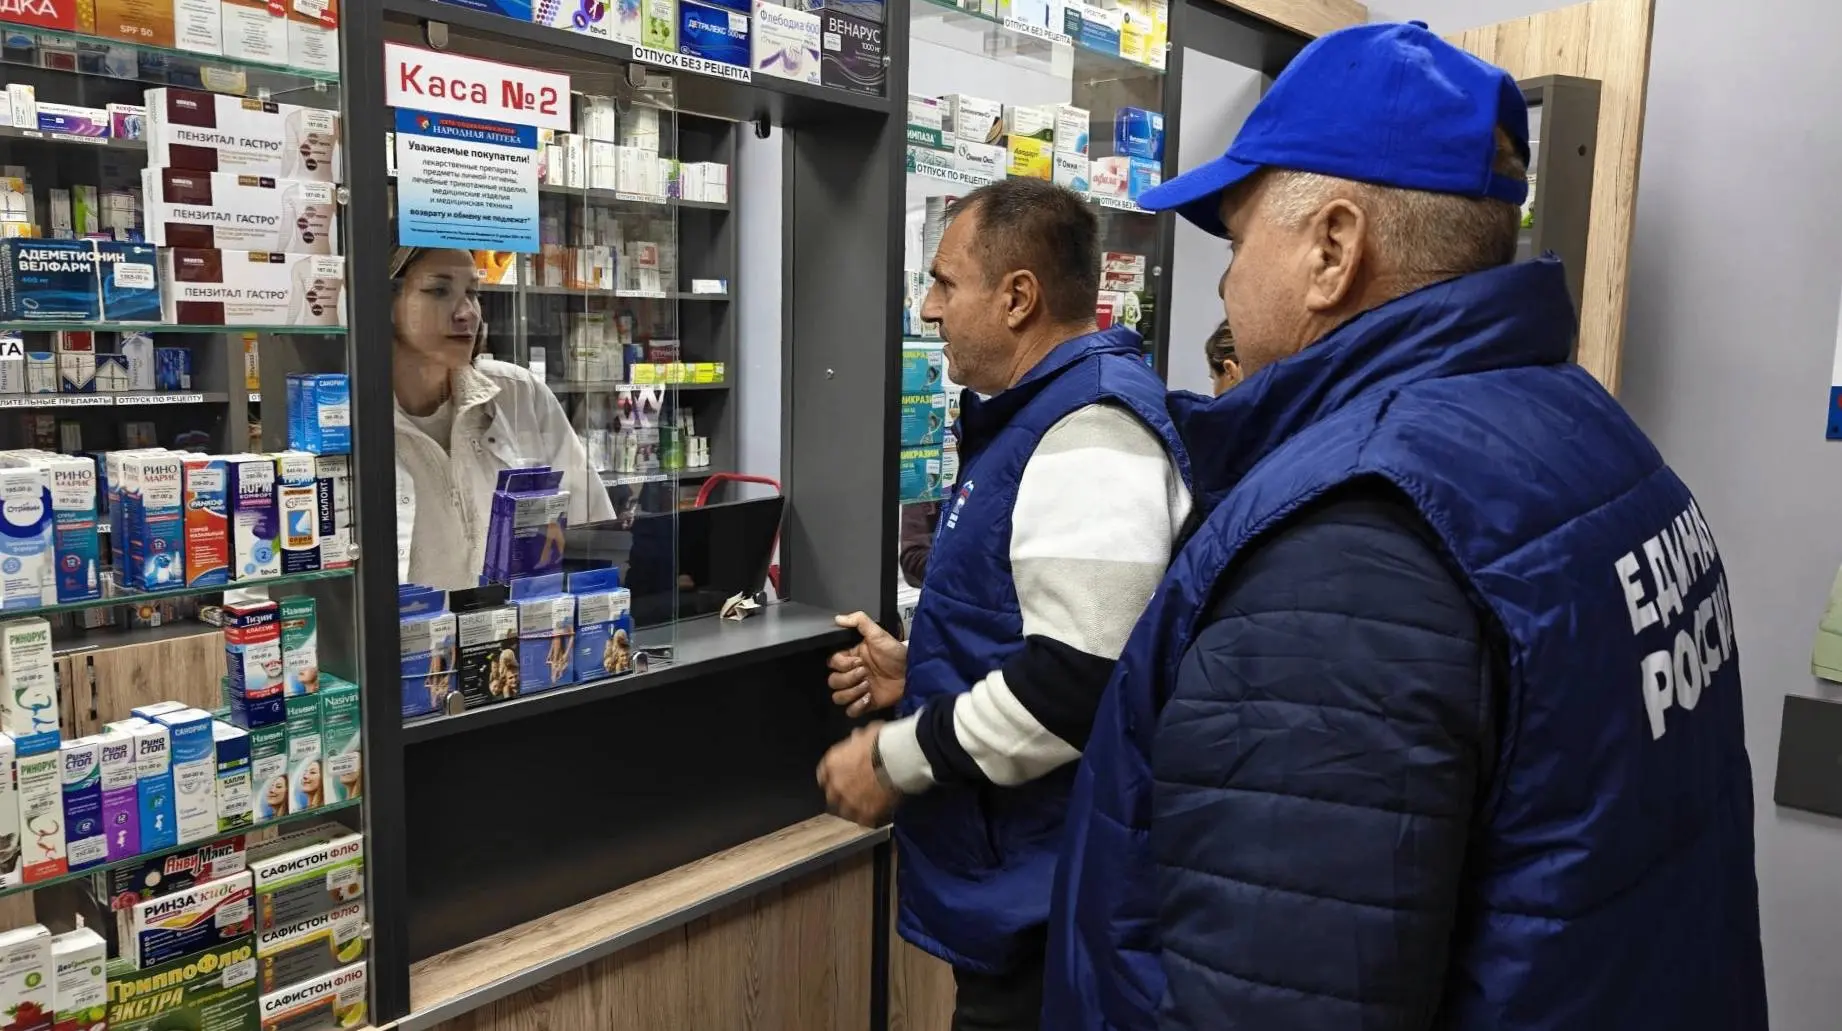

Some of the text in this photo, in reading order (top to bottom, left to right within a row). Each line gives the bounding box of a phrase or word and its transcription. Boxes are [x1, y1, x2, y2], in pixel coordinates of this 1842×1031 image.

[688, 19, 727, 35] ДЕТРАЛЕКС
[760, 9, 819, 35] Флебодиа 600
[119, 24, 153, 37] SPF 50
[590, 25, 607, 36] teva
[828, 17, 881, 44] ВЕНАРУС
[1005, 19, 1071, 45] ОТПУСК БЕЗ РЕЦЕПТА
[861, 42, 875, 52] 1000
[634, 47, 750, 80] ОТПУСК БЕЗ РЕЦЕПТА
[400, 62, 558, 116] Каса №2
[177, 130, 235, 146] ПЕНЗИТАЛ
[433, 124, 521, 144] НАРОДНАЯ АПТЕКА
[408, 140, 530, 164] Уважаемые покупатели!
[422, 159, 478, 171] лекарственные
[423, 168, 460, 179] предметы
[917, 163, 992, 186] ОТПУСК ПО РЕЦЕПТУ
[411, 177, 448, 186] лечебные
[449, 180, 497, 192] трикотажные
[432, 188, 511, 200] медицинские изделия
[436, 198, 484, 208] медицинская
[486, 202, 513, 210] техника
[1122, 200, 1133, 210] БЕЗ
[173, 208, 231, 222] ПЕНЗИТАЛ
[409, 209, 446, 219] возврату
[453, 212, 481, 222] обмену
[18, 249, 126, 263] АДЕМЕТИОНИН
[19, 261, 91, 273] ВЕЛФАРМ
[184, 287, 242, 298] ПЕНЗИТАЛ
[59, 397, 112, 405] ПРЕПАРАТЫ
[118, 395, 202, 404] ОТПУСК ПО РЕЦЕПТУ
[55, 469, 91, 481] РИНО
[143, 464, 178, 476] РИНО
[7, 505, 40, 513] Отривин
[261, 551, 267, 560] 2
[260, 568, 278, 576] teva
[1614, 497, 1716, 635] ЕДИНА
[282, 605, 313, 617] Називин
[245, 613, 274, 625] Тизин
[245, 624, 274, 634] КЛАССИК
[9, 629, 47, 645] РИНОРУС
[1640, 571, 1733, 741] РОССИ
[324, 693, 359, 708] Nasivin
[287, 704, 317, 717] Називин
[174, 723, 207, 736] САНОРИН
[252, 731, 283, 744] Називин
[21, 758, 57, 776] РИНОРУС
[224, 774, 246, 785] КАПЛИ
[260, 851, 328, 879] САФИСТОН
[330, 842, 359, 859] ФЛЮ
[144, 895, 197, 919] РИНЗА
[262, 904, 360, 944] САФИСТОН ФЛЮ
[107, 945, 252, 1003] ГриппоФлю
[265, 969, 363, 1011] САФИСТОН ФЛЮ
[110, 987, 184, 1022] ЭКСТРА
